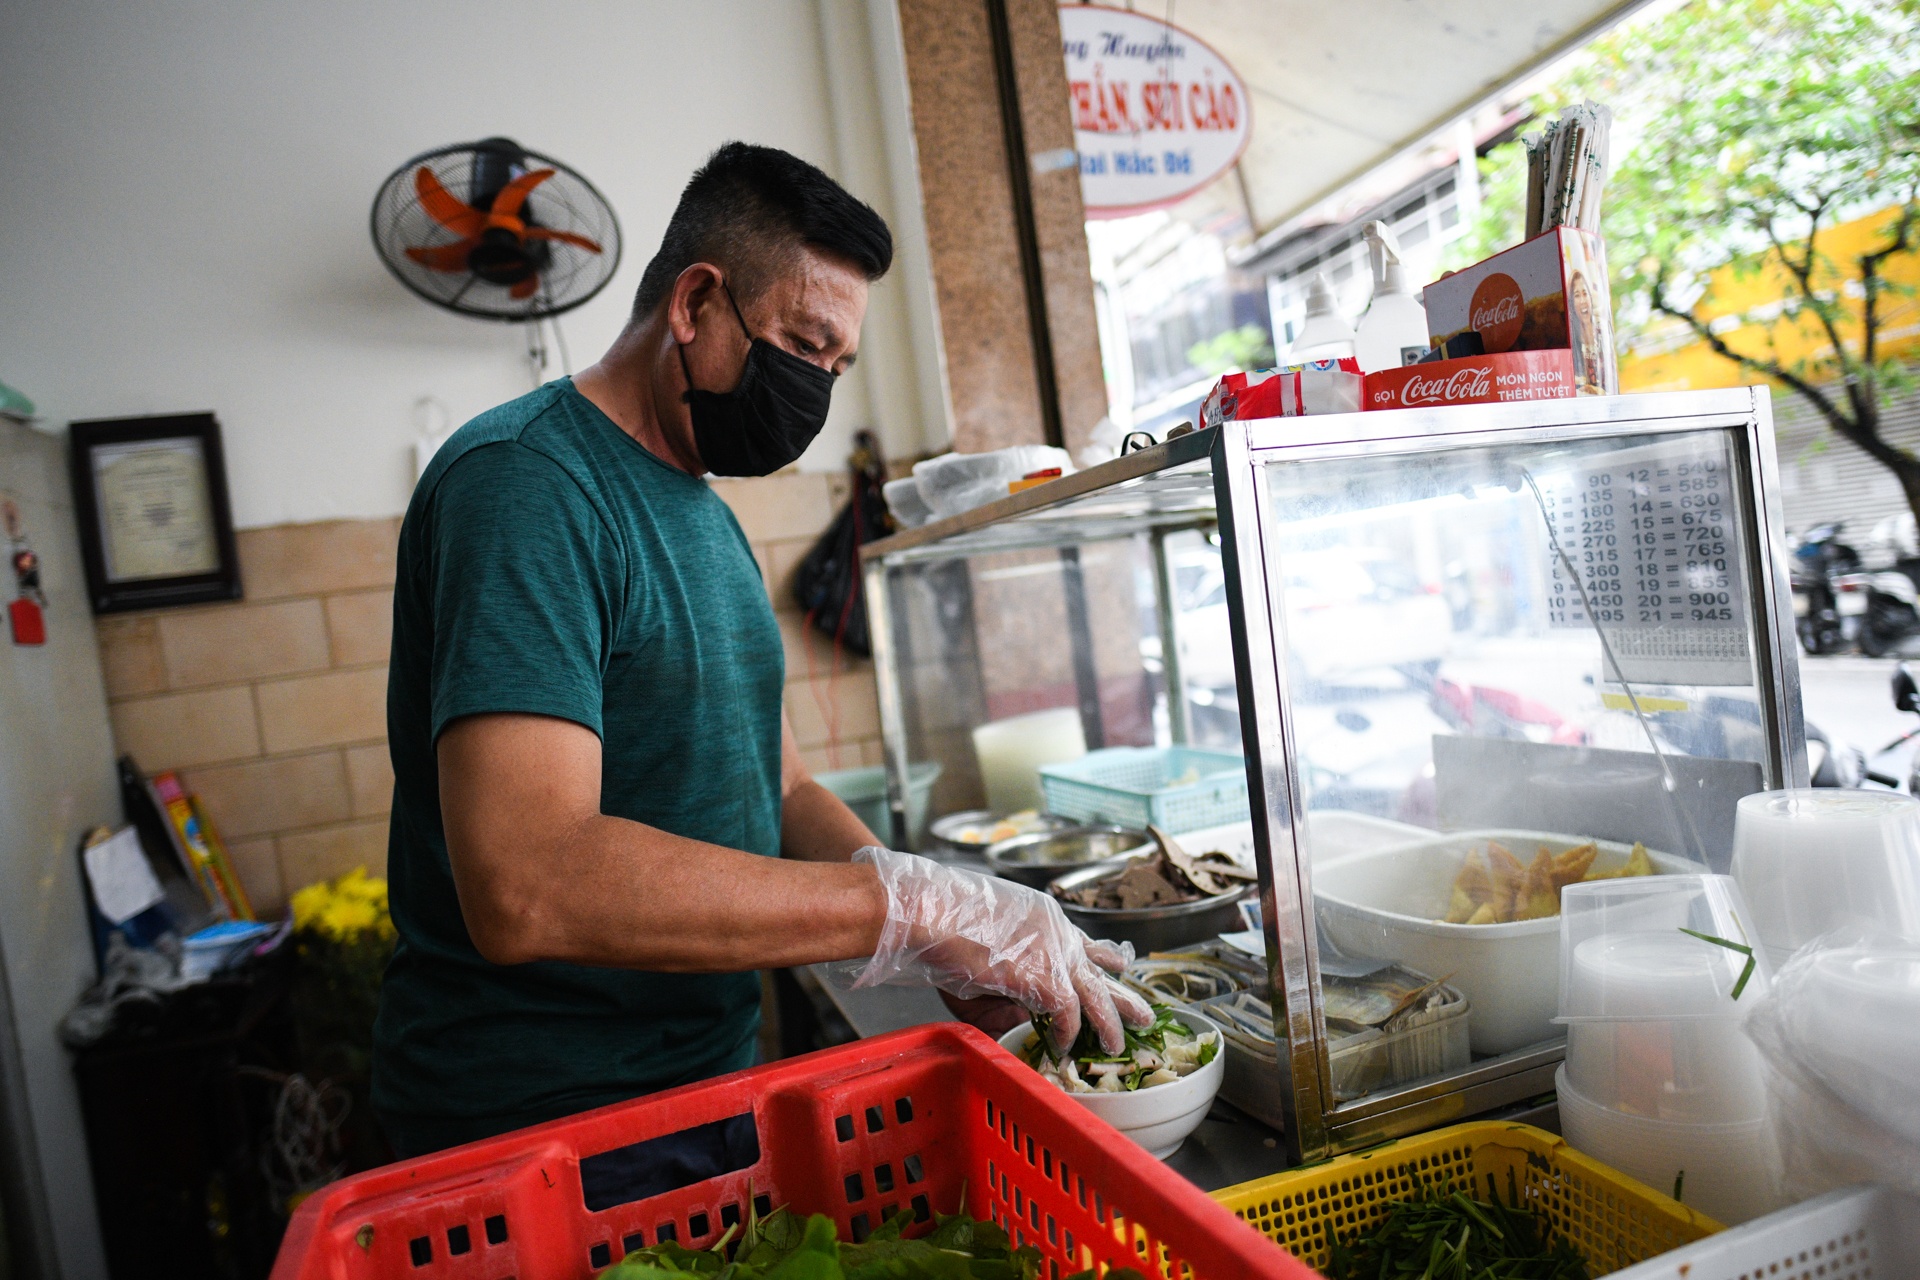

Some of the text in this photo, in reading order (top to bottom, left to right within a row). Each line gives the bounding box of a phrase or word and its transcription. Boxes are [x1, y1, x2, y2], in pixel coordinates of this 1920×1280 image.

[1374, 367, 1493, 405] GỌI Coca-Cola
[1496, 371, 1563, 387] MÓN NGON
[1498, 385, 1570, 401] THÊM TUYỆT
[1589, 473, 1611, 487] 90
[1626, 469, 1649, 482] 12
[1628, 484, 1650, 499] 1
[1679, 475, 1719, 492] 585
[1580, 489, 1613, 503] 135
[1630, 501, 1653, 514] 14
[1680, 493, 1720, 508] 630
[1581, 504, 1614, 519] 180
[1582, 519, 1615, 534] 225
[1631, 516, 1654, 530] 15
[1682, 509, 1722, 525] 675
[1583, 534, 1616, 549] 270
[1632, 532, 1655, 545] 16
[1683, 526, 1723, 541] 720
[1584, 549, 1618, 563] 315
[1634, 547, 1656, 560] 17
[1684, 542, 1725, 557] 765
[1586, 564, 1619, 578] 360
[1635, 563, 1658, 576] 18
[1587, 579, 1621, 592] 405
[1637, 579, 1660, 592] 19
[1589, 594, 1623, 607] 450
[1638, 594, 1661, 607] 20
[1689, 592, 1729, 606] 900
[1640, 610, 1661, 621] 21
[1691, 608, 1732, 621] 945
